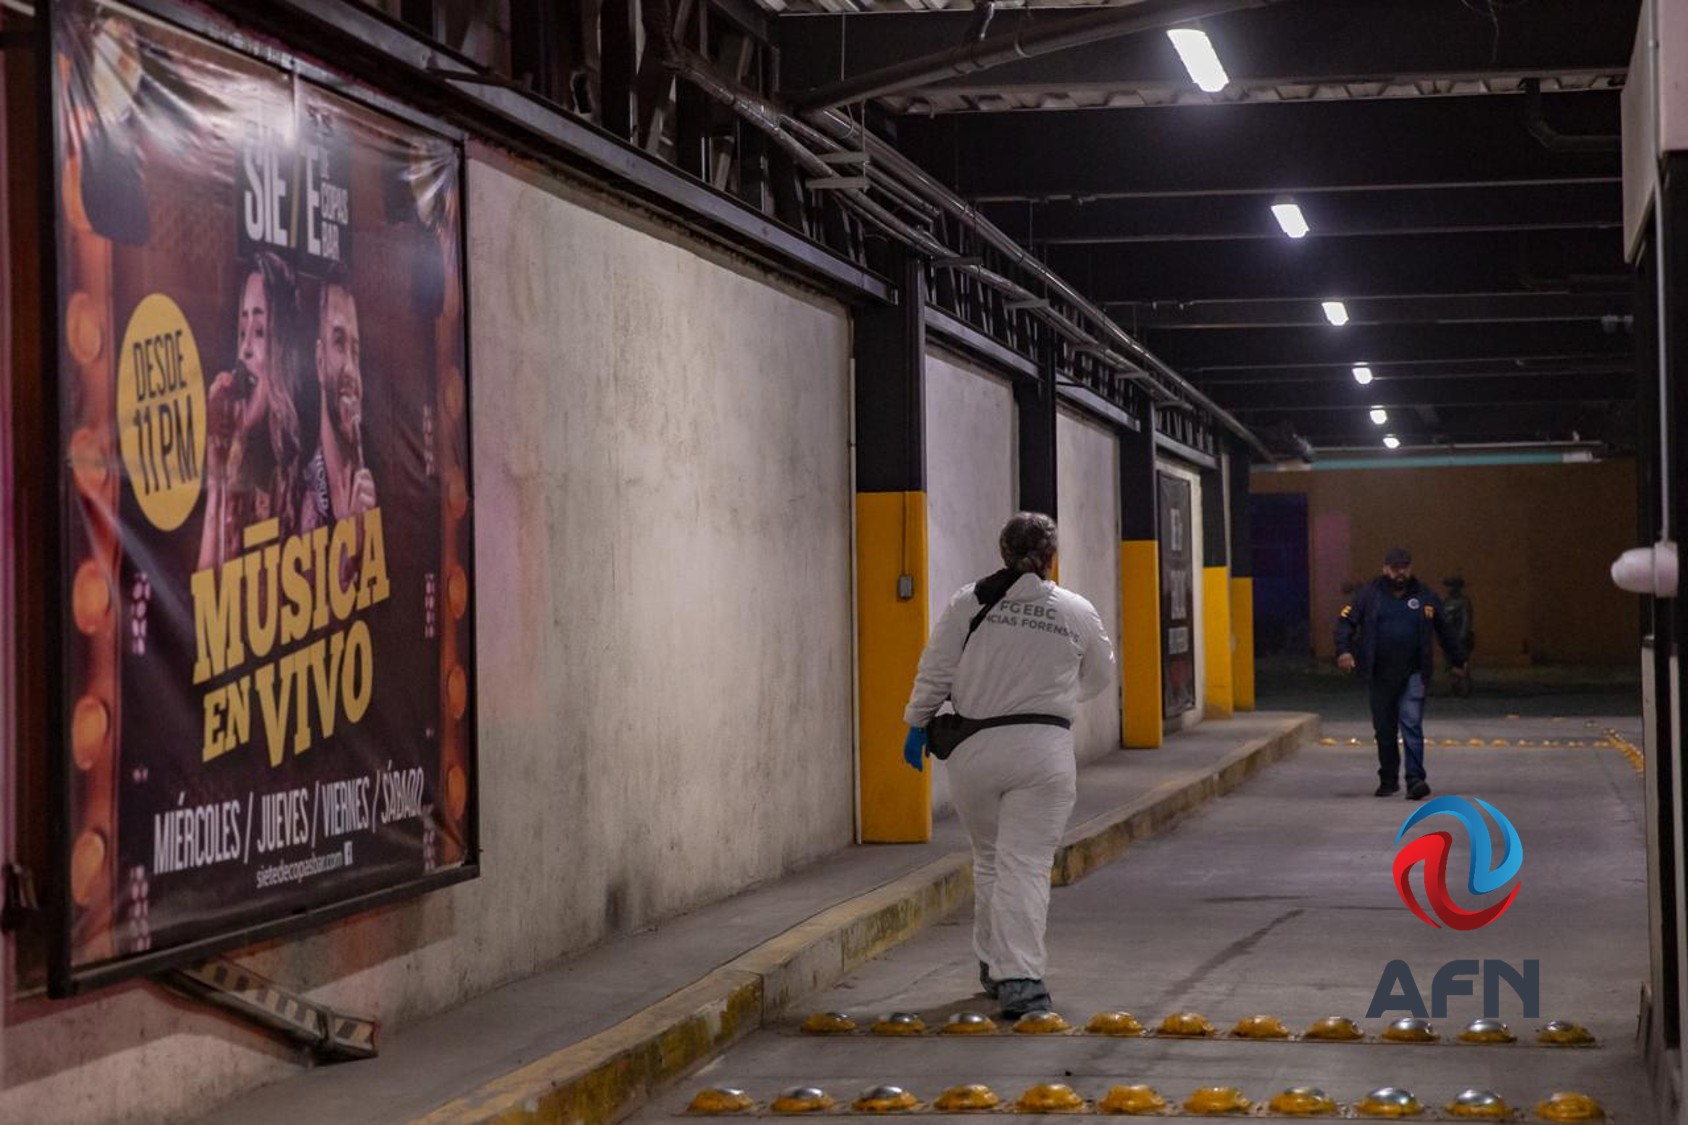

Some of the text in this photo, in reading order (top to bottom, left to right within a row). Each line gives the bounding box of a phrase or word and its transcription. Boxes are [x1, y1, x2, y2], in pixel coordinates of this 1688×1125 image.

[133, 329, 188, 402] DESDE
[202, 620, 373, 768] EN VIVO
[153, 792, 241, 875] MIÉRCOLES
[256, 788, 309, 853] JUEVES
[321, 776, 371, 838] VIERNES
[381, 759, 424, 824] SÁBADO
